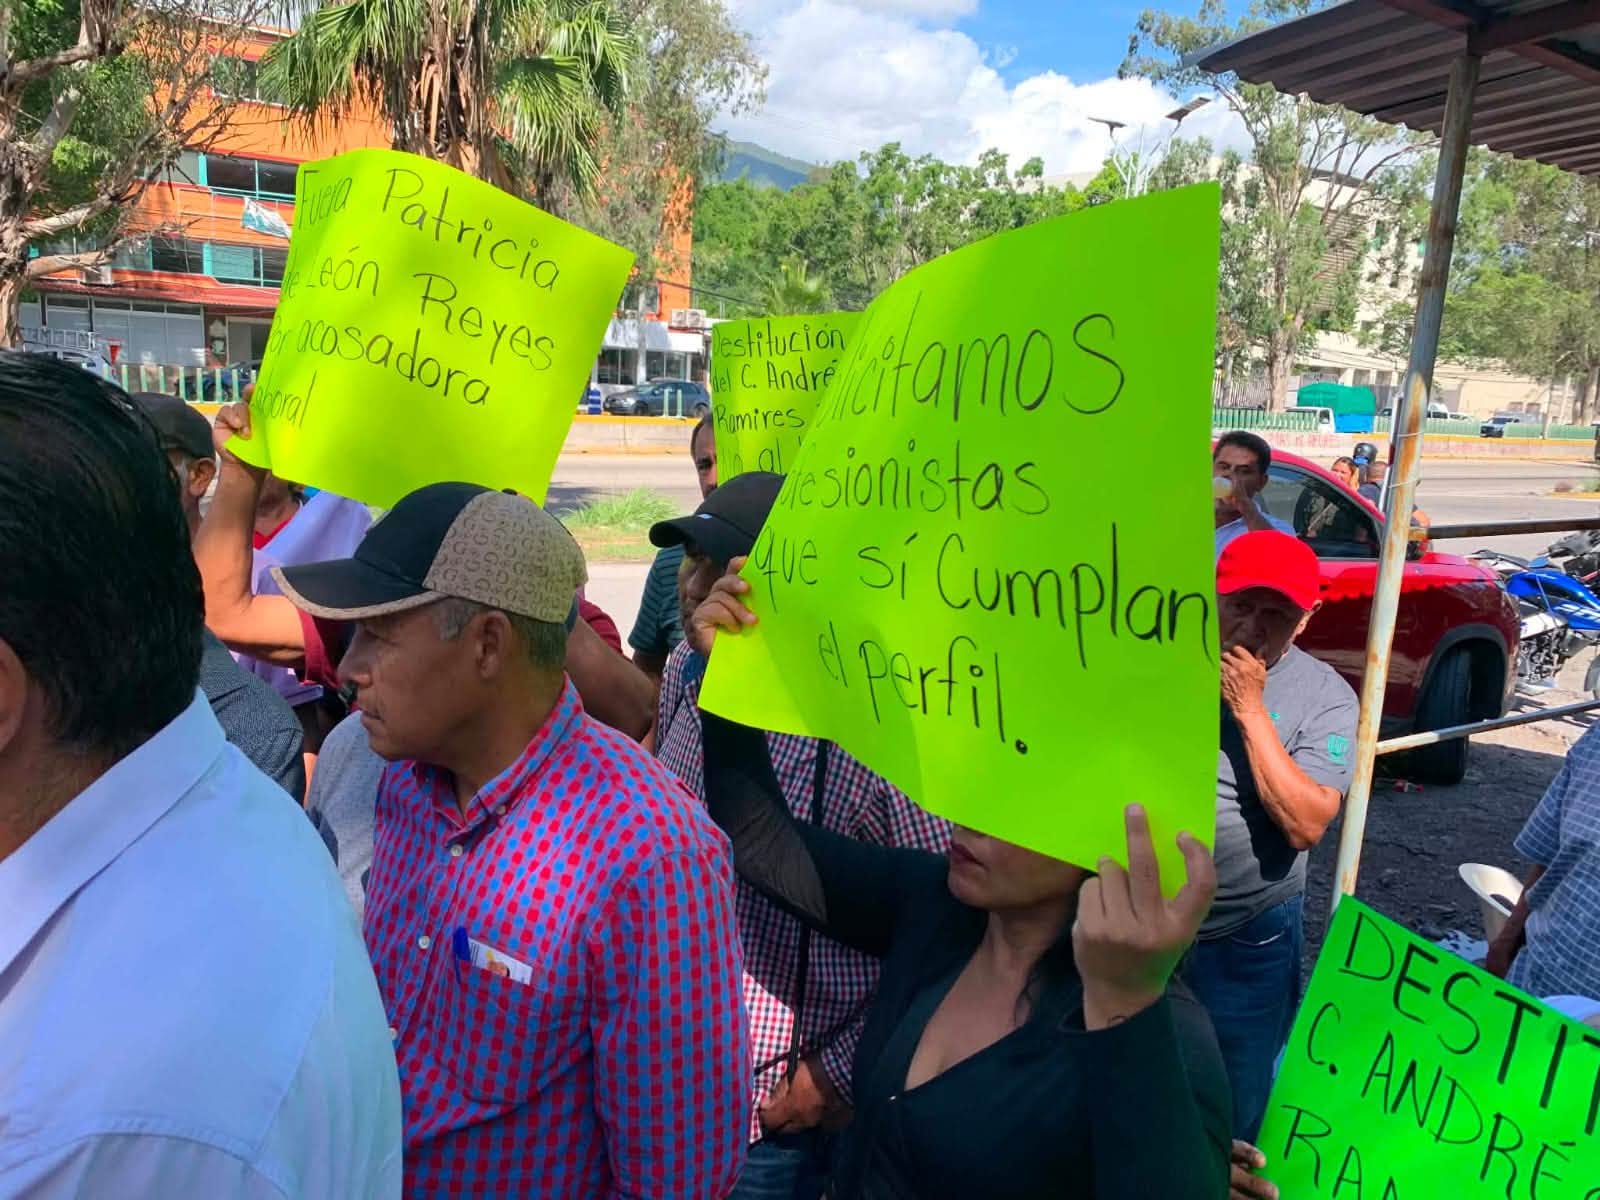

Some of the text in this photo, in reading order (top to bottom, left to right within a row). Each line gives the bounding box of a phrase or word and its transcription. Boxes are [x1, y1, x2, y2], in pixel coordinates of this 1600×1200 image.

[298, 168, 561, 291] Fuera Patricia
[297, 319, 492, 406] acosadora
[412, 272, 555, 371] Reyes
[251, 367, 318, 429] aboral
[714, 403, 806, 434] Ramires
[741, 362, 757, 390] C.
[755, 525, 818, 613] que
[857, 530, 919, 600] sí
[818, 621, 848, 689] el
[1306, 1001, 1600, 1200] C. ANDRÉ
[1280, 1103, 1399, 1200] RA
